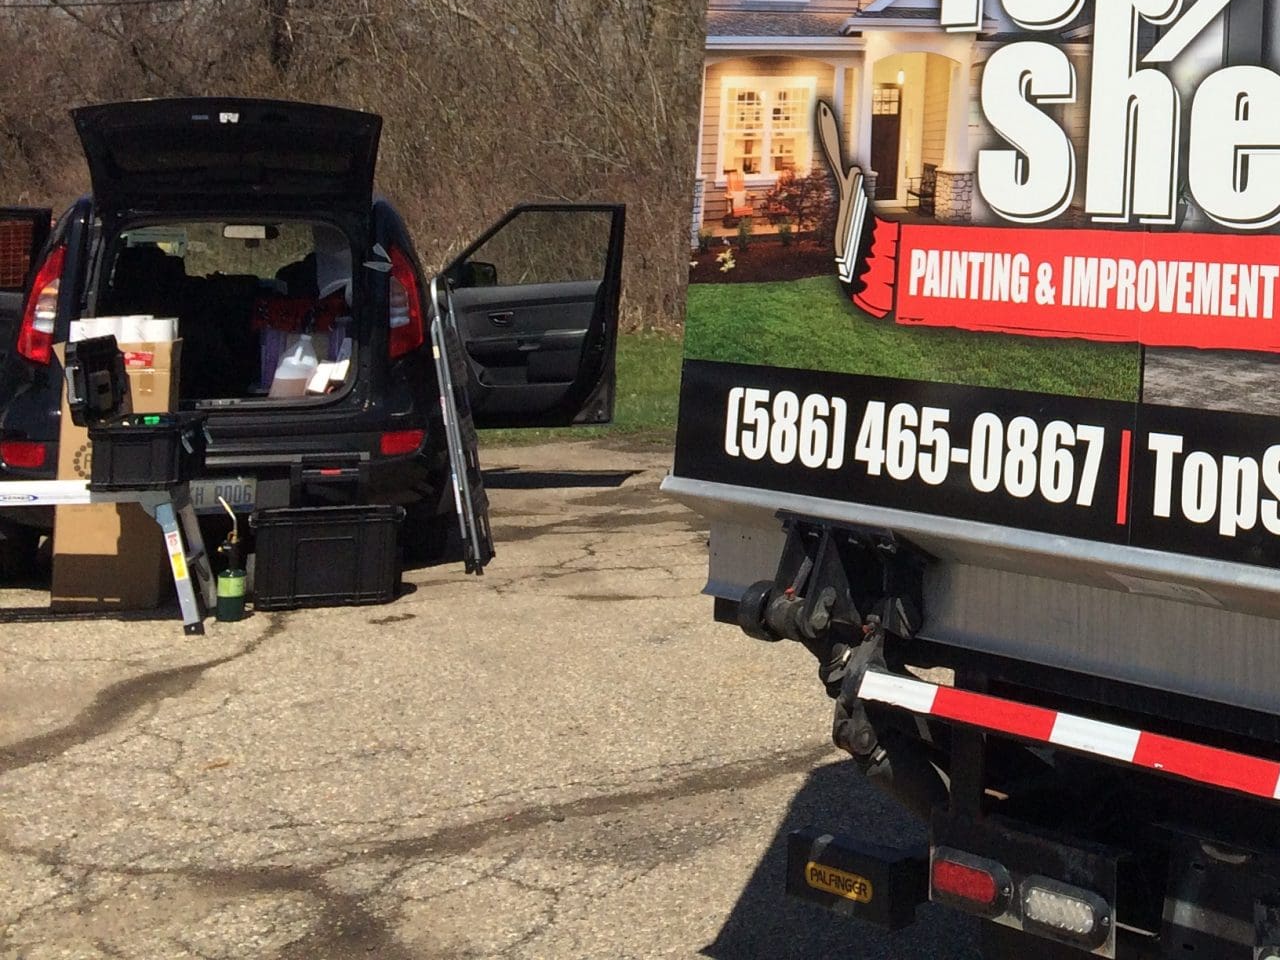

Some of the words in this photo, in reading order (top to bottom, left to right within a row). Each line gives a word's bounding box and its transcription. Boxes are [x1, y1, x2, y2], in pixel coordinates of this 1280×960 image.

[908, 248, 1030, 305] PAINTING
[1035, 262, 1056, 305] &
[1062, 253, 1280, 320] IMPROVEMENT
[724, 386, 848, 470] (586)
[854, 400, 1106, 507] 465-0867
[810, 867, 868, 898] PALFINGER
